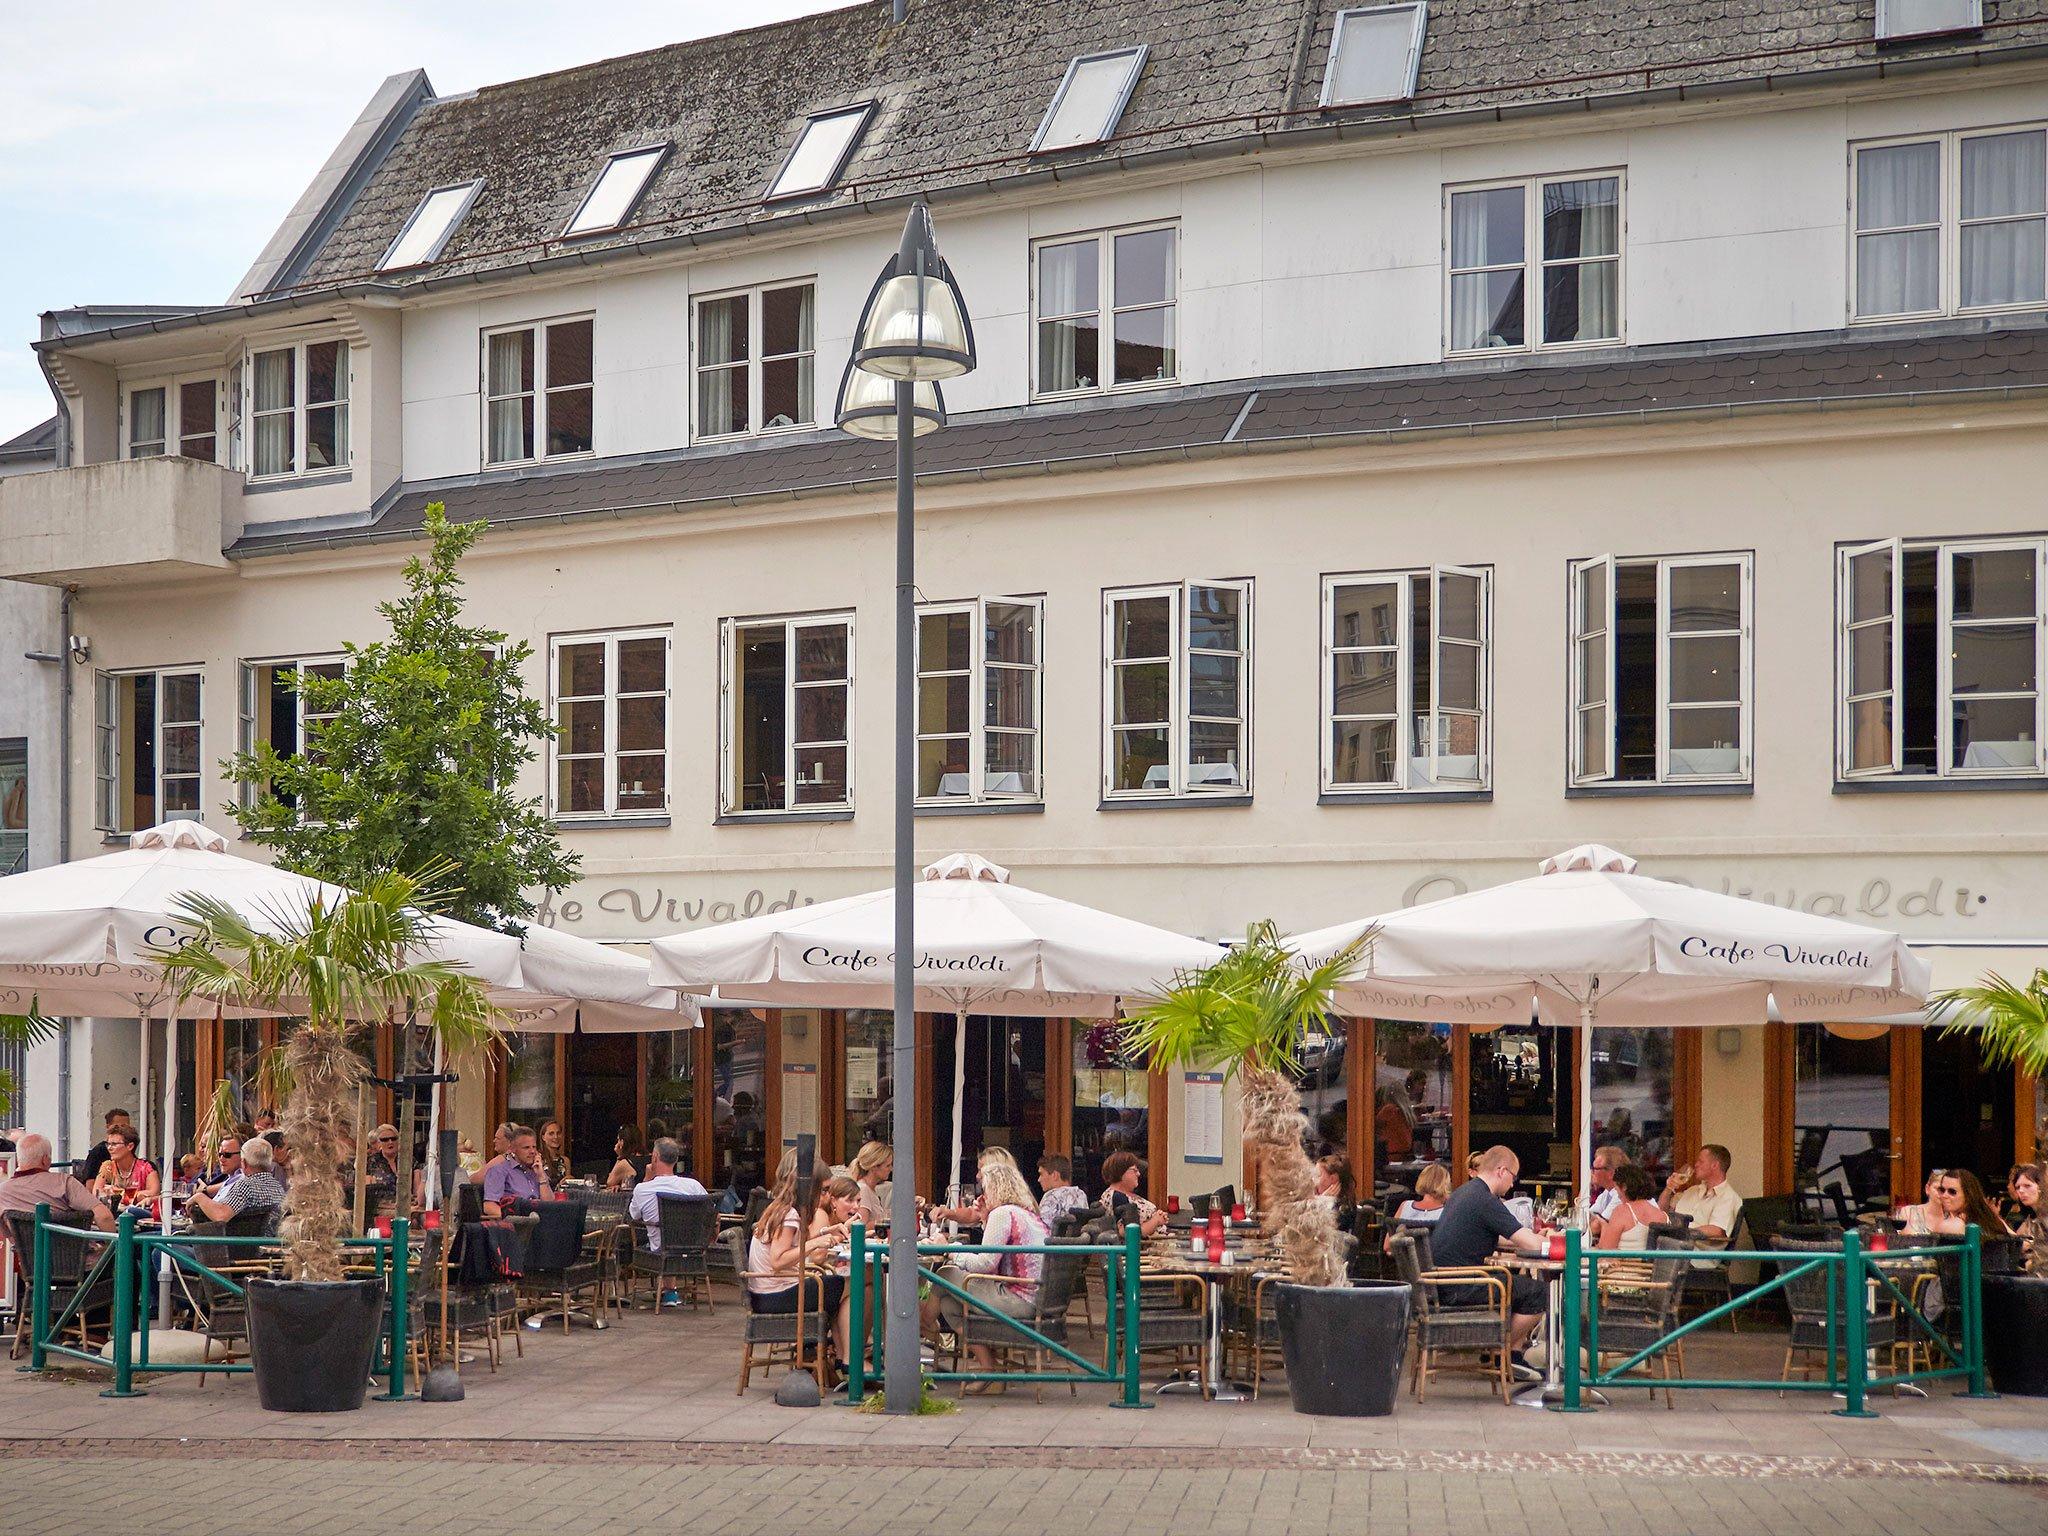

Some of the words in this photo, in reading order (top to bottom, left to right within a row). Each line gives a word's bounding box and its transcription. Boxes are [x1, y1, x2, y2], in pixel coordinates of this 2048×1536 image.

[802, 947, 877, 971] Cafe
[1679, 936, 1755, 965] Cafe
[1763, 944, 1869, 968] Vivaldi
